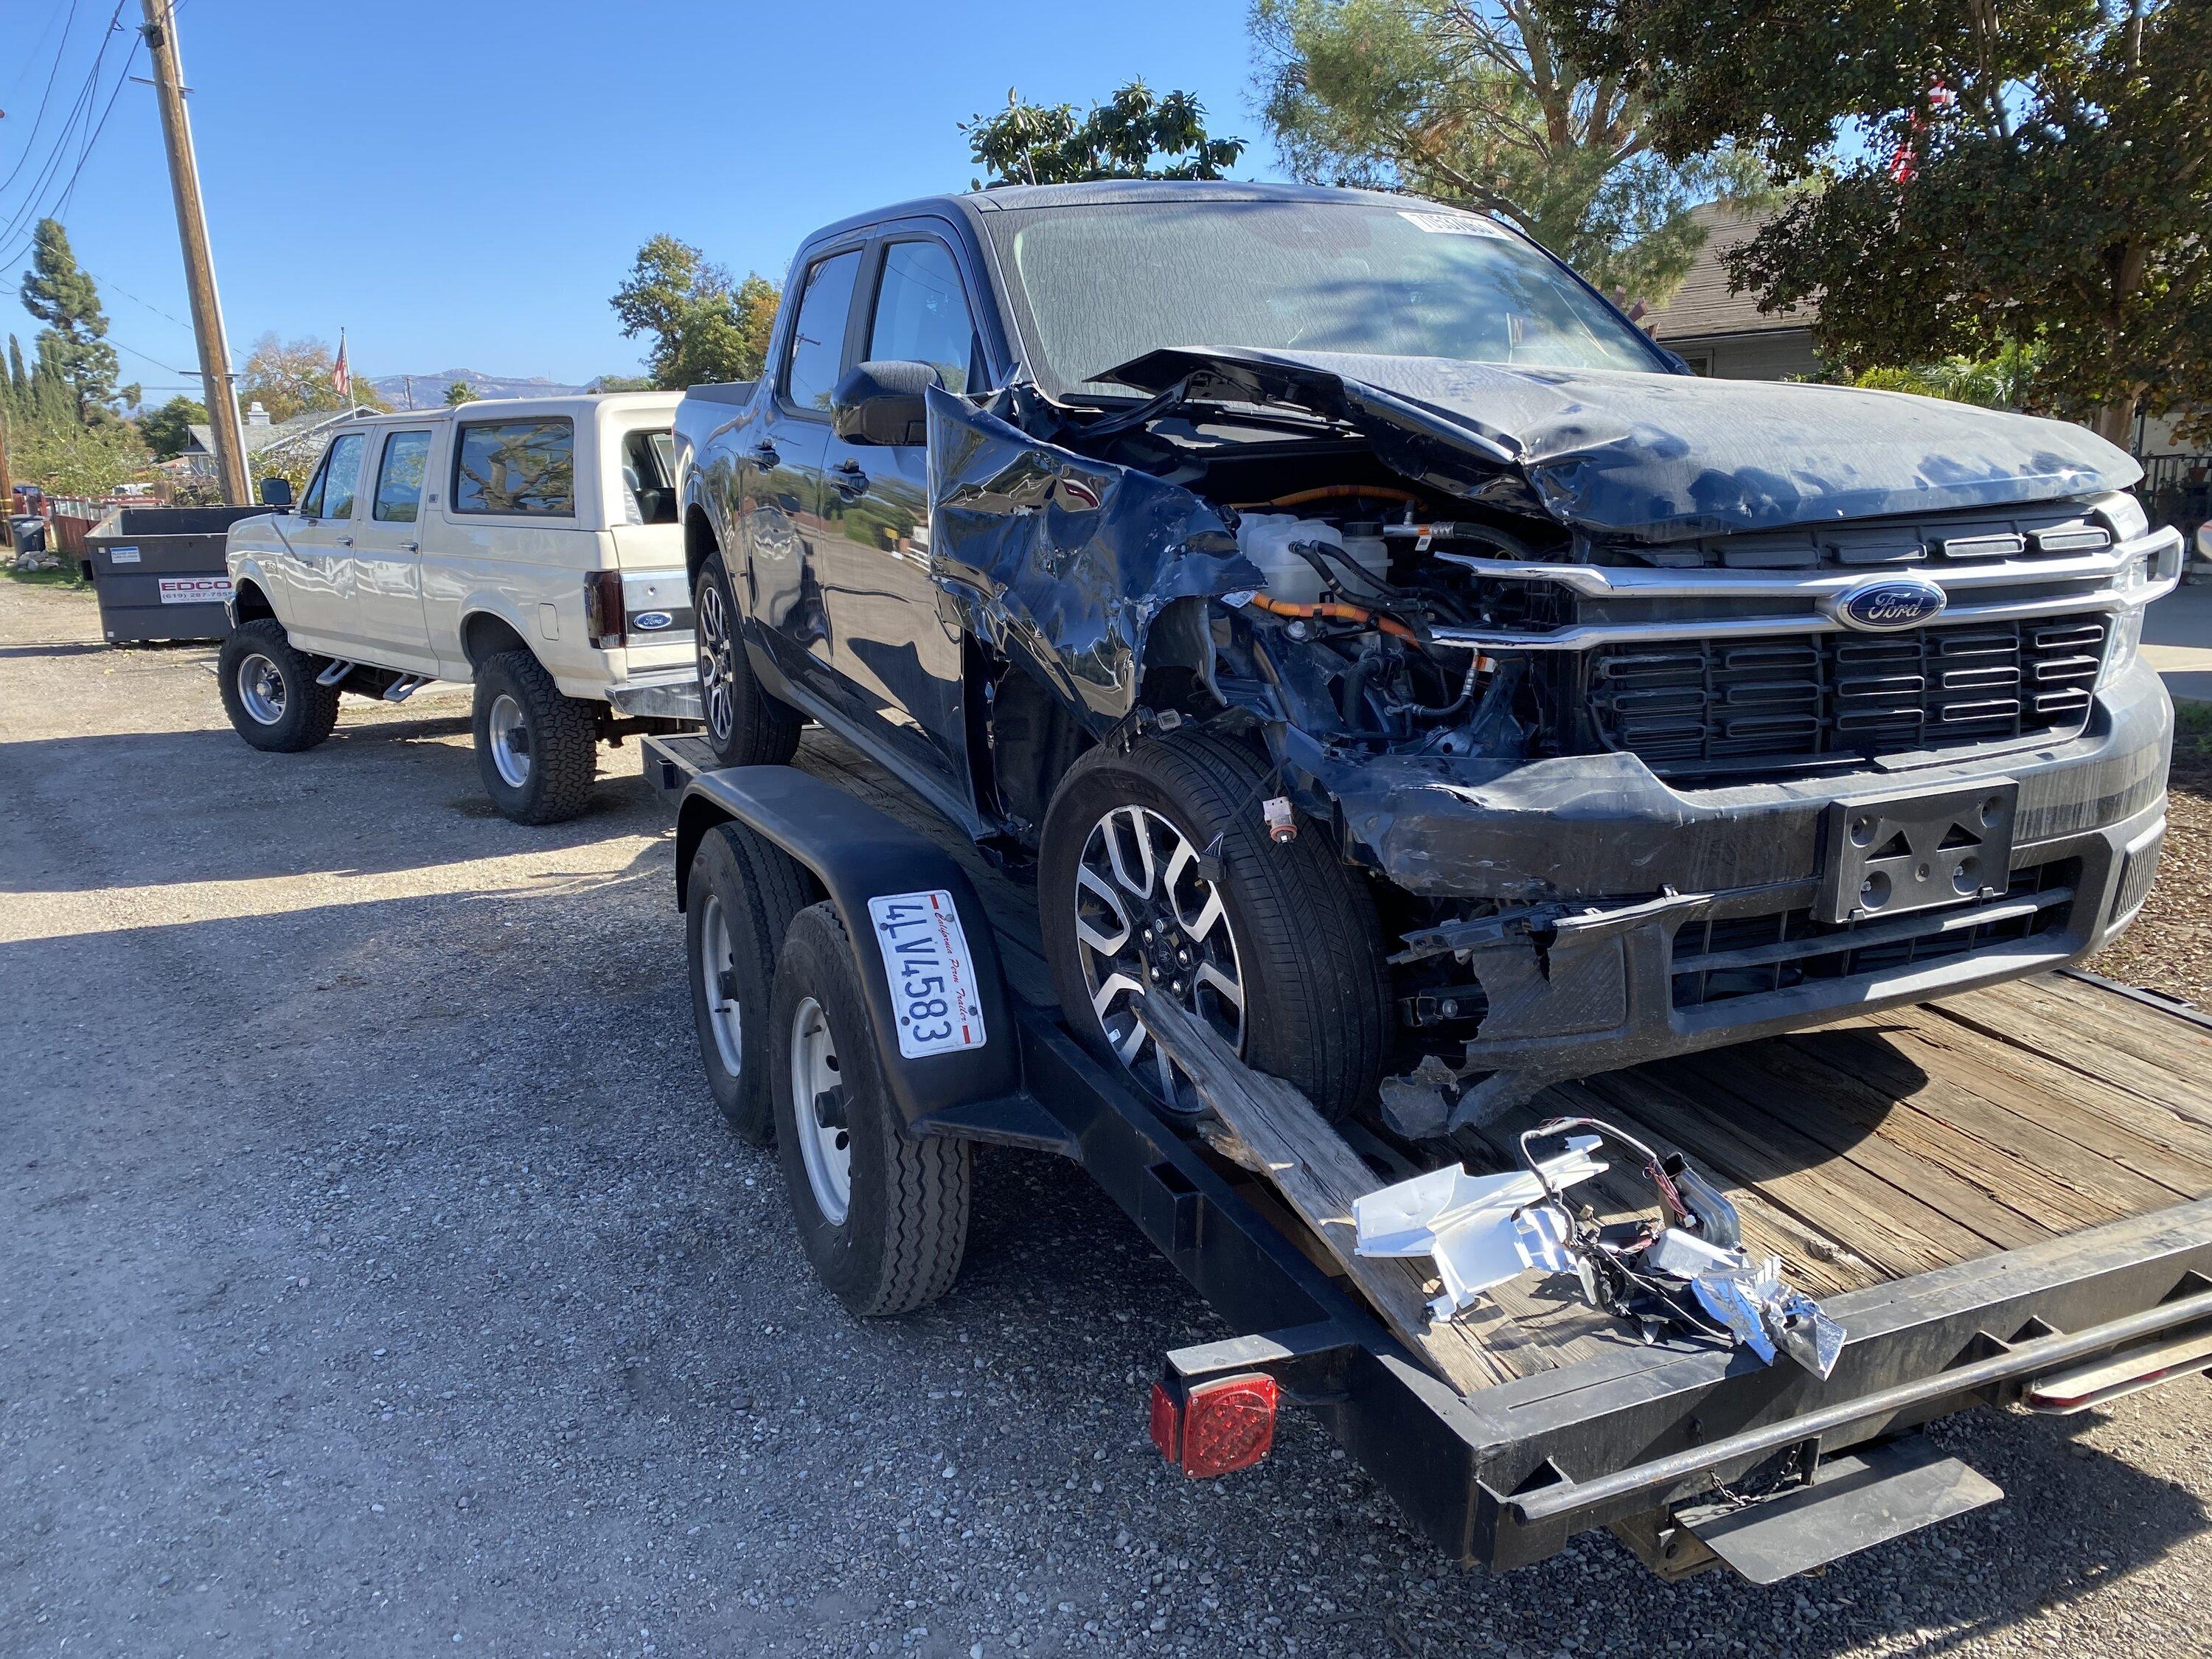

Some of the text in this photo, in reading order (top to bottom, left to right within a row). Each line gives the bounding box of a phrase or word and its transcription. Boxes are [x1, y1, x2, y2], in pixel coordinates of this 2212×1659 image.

[161, 581, 232, 591] EDCO
[1868, 592, 1924, 619] Ford
[643, 616, 664, 625] Ford
[886, 905, 952, 1042] 4LV4583
[935, 912, 968, 1022] California Perm Trailer
